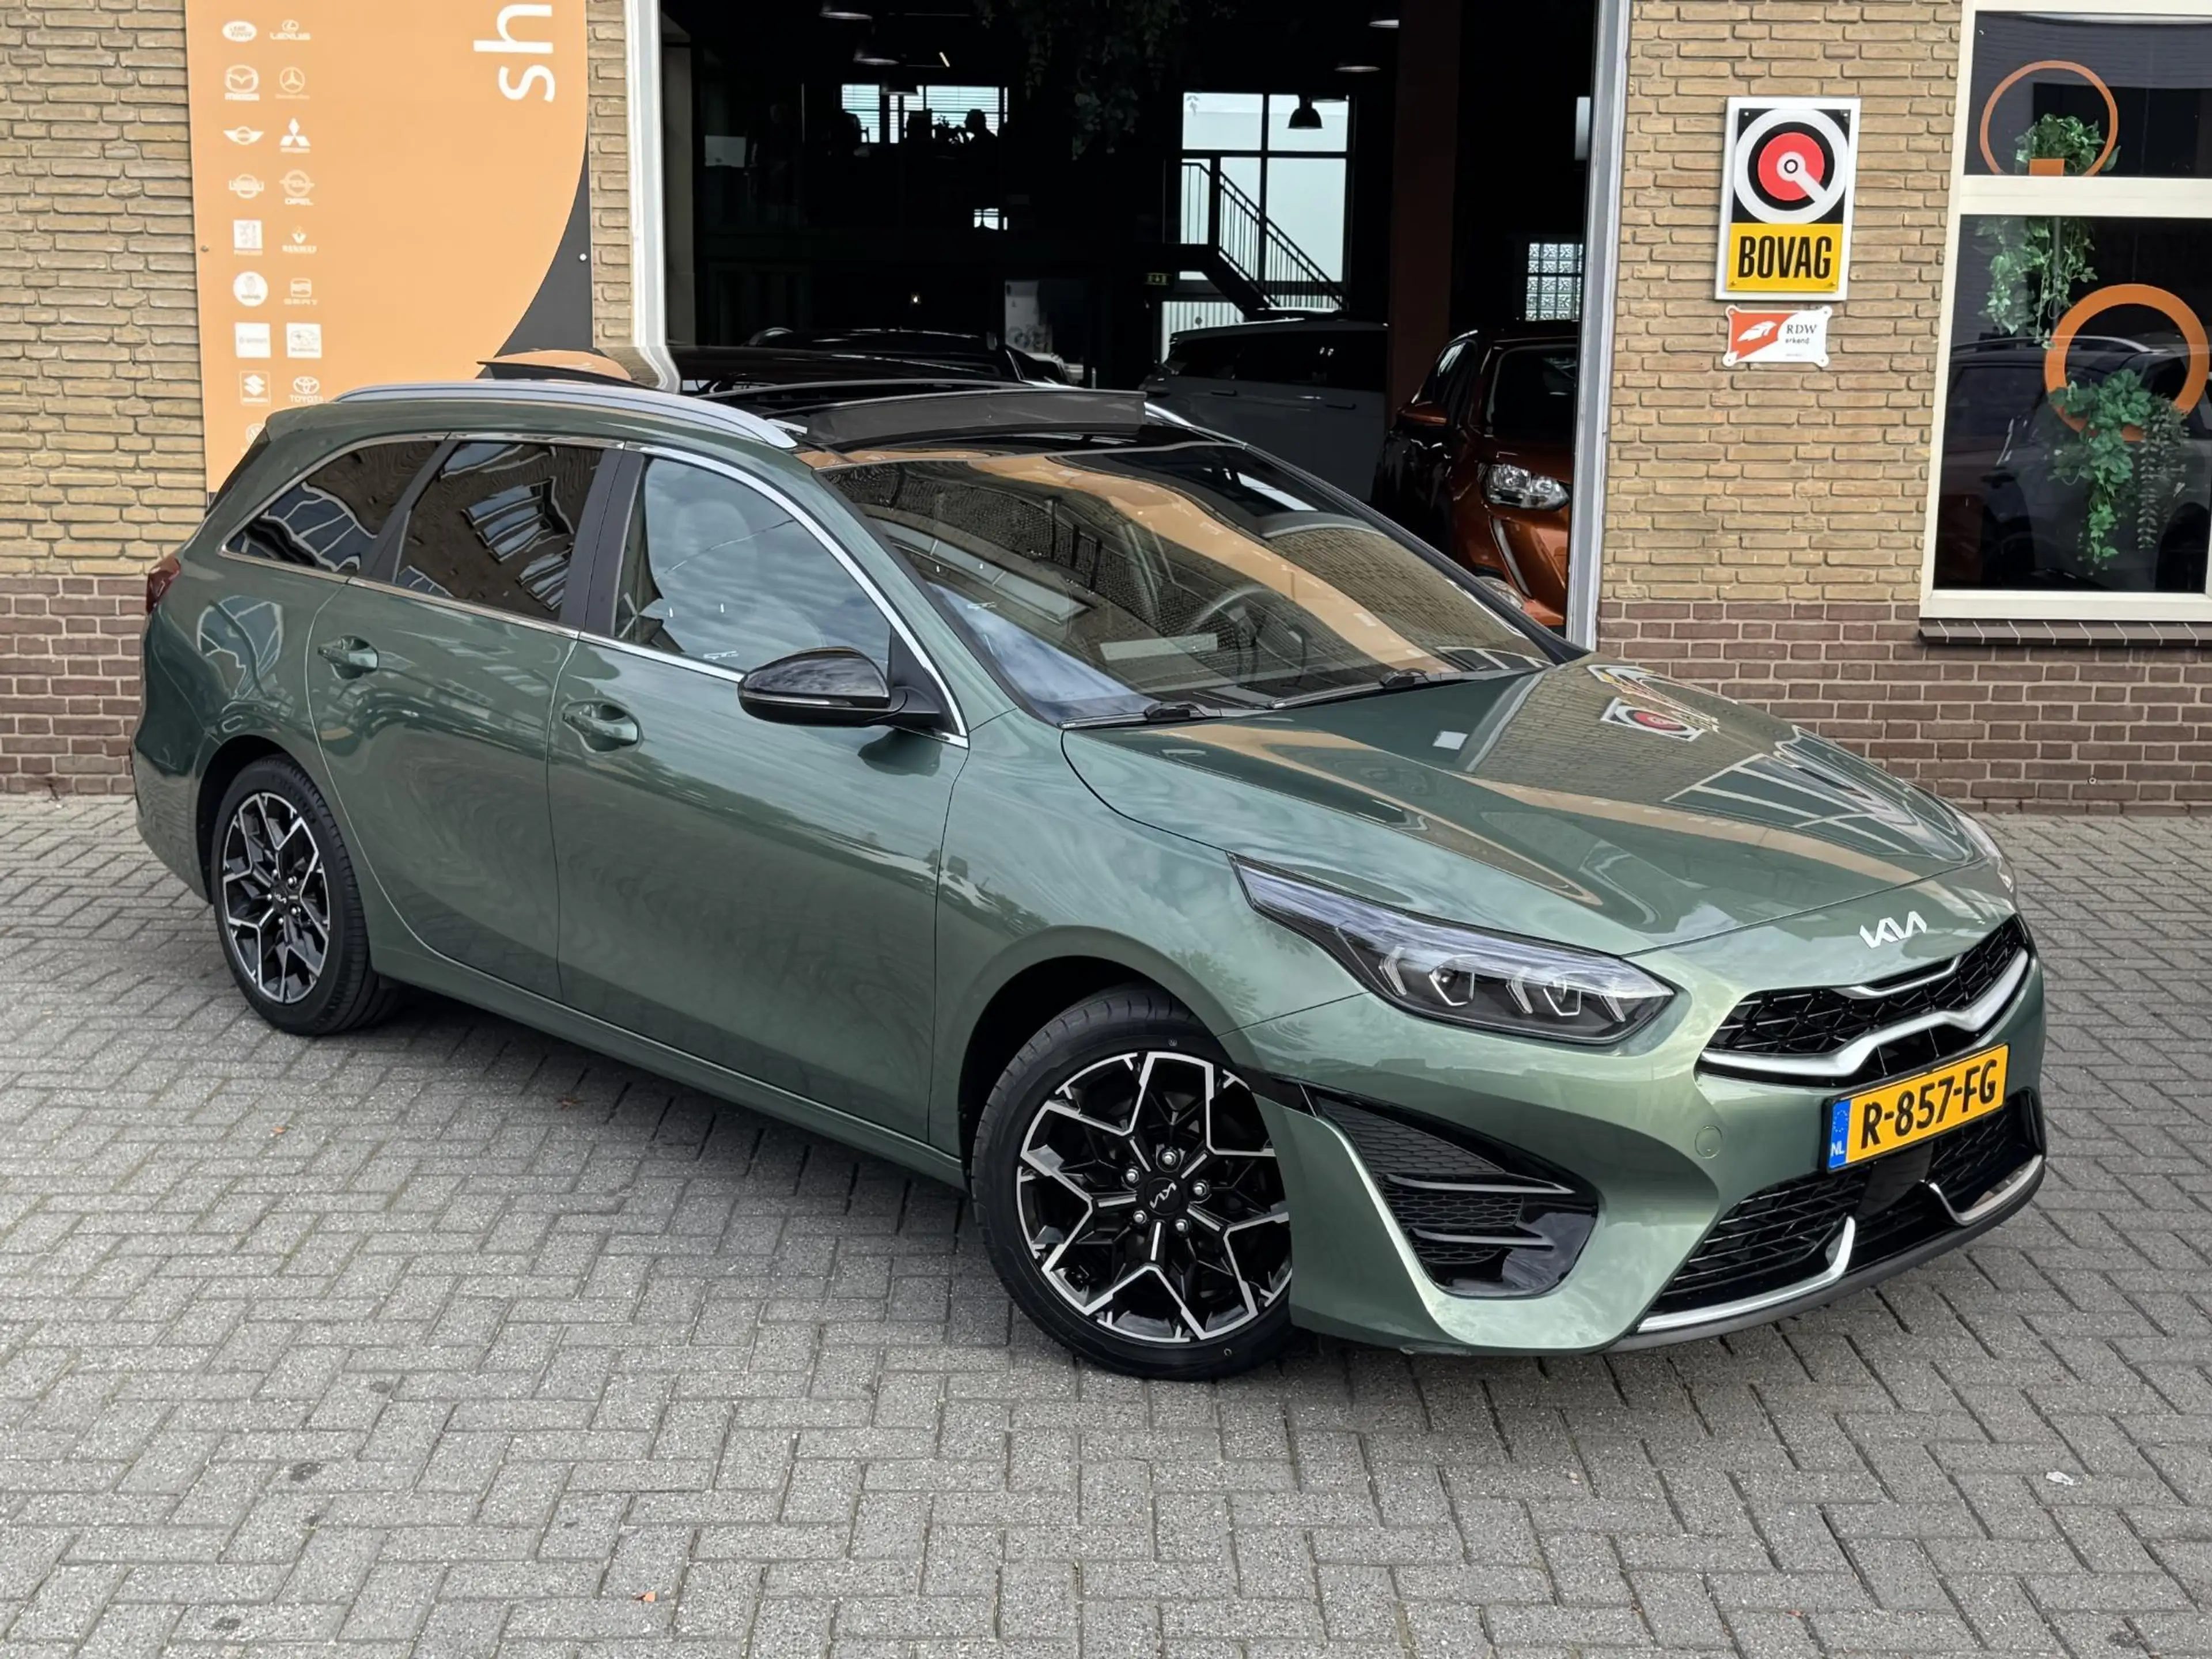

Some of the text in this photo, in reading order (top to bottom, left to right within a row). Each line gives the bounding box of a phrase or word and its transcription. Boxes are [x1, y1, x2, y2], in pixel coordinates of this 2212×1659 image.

[473, 4, 555, 103] sh
[1737, 235, 1832, 279] BOVAG
[1786, 324, 1817, 335] RDW
[1860, 1058, 1998, 1150] R-857-FG
[1831, 1142, 1845, 1157] NL
